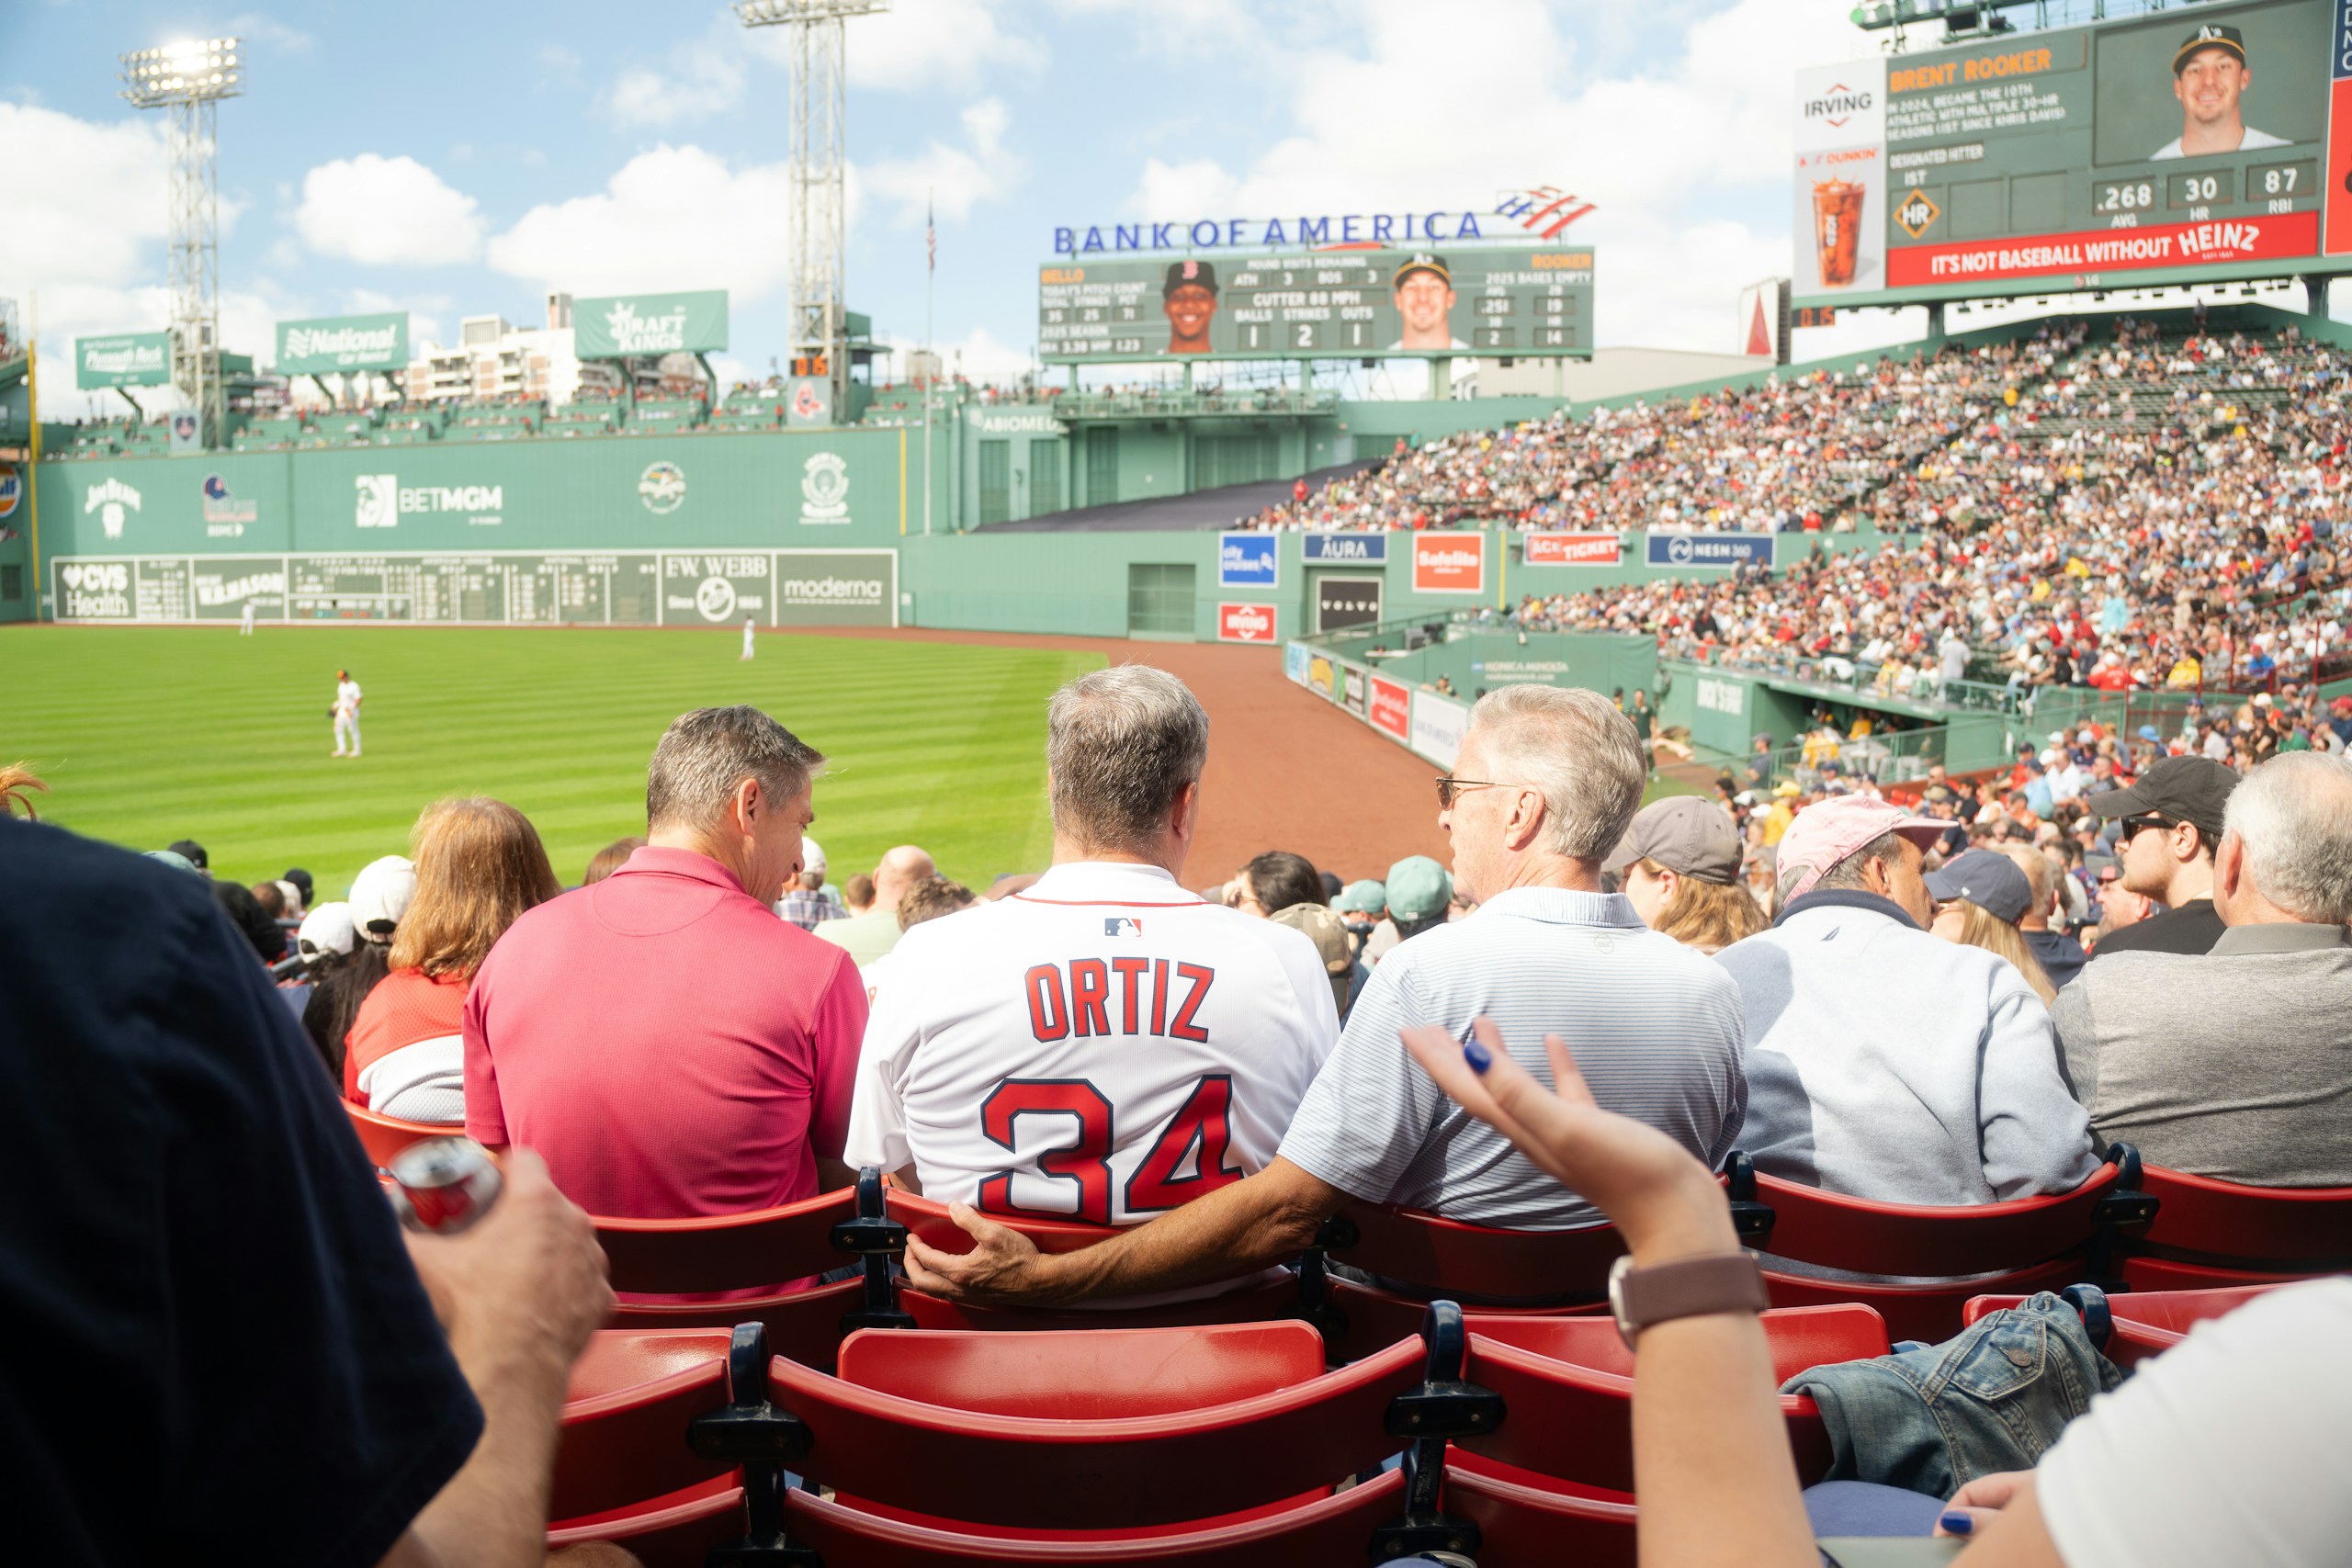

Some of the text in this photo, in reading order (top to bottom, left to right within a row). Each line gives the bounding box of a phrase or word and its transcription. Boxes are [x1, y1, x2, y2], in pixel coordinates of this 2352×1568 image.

[1890, 48, 2052, 93] BRENT ROOKER
[1804, 93, 1872, 118] IRVING
[1887, 103, 1898, 114] IN
[1933, 90, 1977, 107] BECAME
[1980, 87, 2001, 101] THE
[1887, 111, 1937, 128] ATHLETIC
[1939, 107, 1964, 120] WITH
[1966, 100, 2019, 118] MULTIPLE
[1887, 122, 1934, 141] SEASONS
[1962, 116, 1993, 131] SINCE
[1890, 143, 1984, 169] DESIGNATED HITTER
[2186, 176, 2218, 202] 30
[2265, 168, 2298, 194] 87
[2098, 184, 2152, 211] .268
[2268, 198, 2292, 214] RBI
[1902, 203, 1930, 226] HR
[2110, 213, 2138, 229] AVG
[2190, 206, 2210, 221] HR
[1055, 211, 1481, 254] BANK OF AMERICA
[1532, 254, 1592, 269] ROOKER
[1932, 223, 2260, 275] IT'S NOT BASEBALL WITHOUT HEINZ
[1114, 282, 1147, 294] COUNT
[1367, 269, 1377, 284] 3
[1252, 291, 1306, 307] CUTTER
[1332, 290, 1361, 305] MPH
[1235, 306, 1374, 321] BALLS STRIKES OUTS
[309, 323, 397, 355] National
[610, 314, 686, 352] DRAFT KINGS
[1250, 323, 1361, 347] 1 2 1
[399, 485, 503, 513] BETMGM
[1419, 549, 1479, 568] Safelite
[1532, 539, 1618, 560] ACE TICKET
[1693, 543, 1730, 558] NESN
[83, 563, 129, 592] CVS
[705, 556, 768, 578] WEBB
[785, 575, 883, 598] moderna
[66, 591, 130, 616] Health
[1227, 615, 1269, 631] IRVING
[1024, 956, 1215, 1043] ORTIZ
[978, 1074, 1244, 1225] 34
